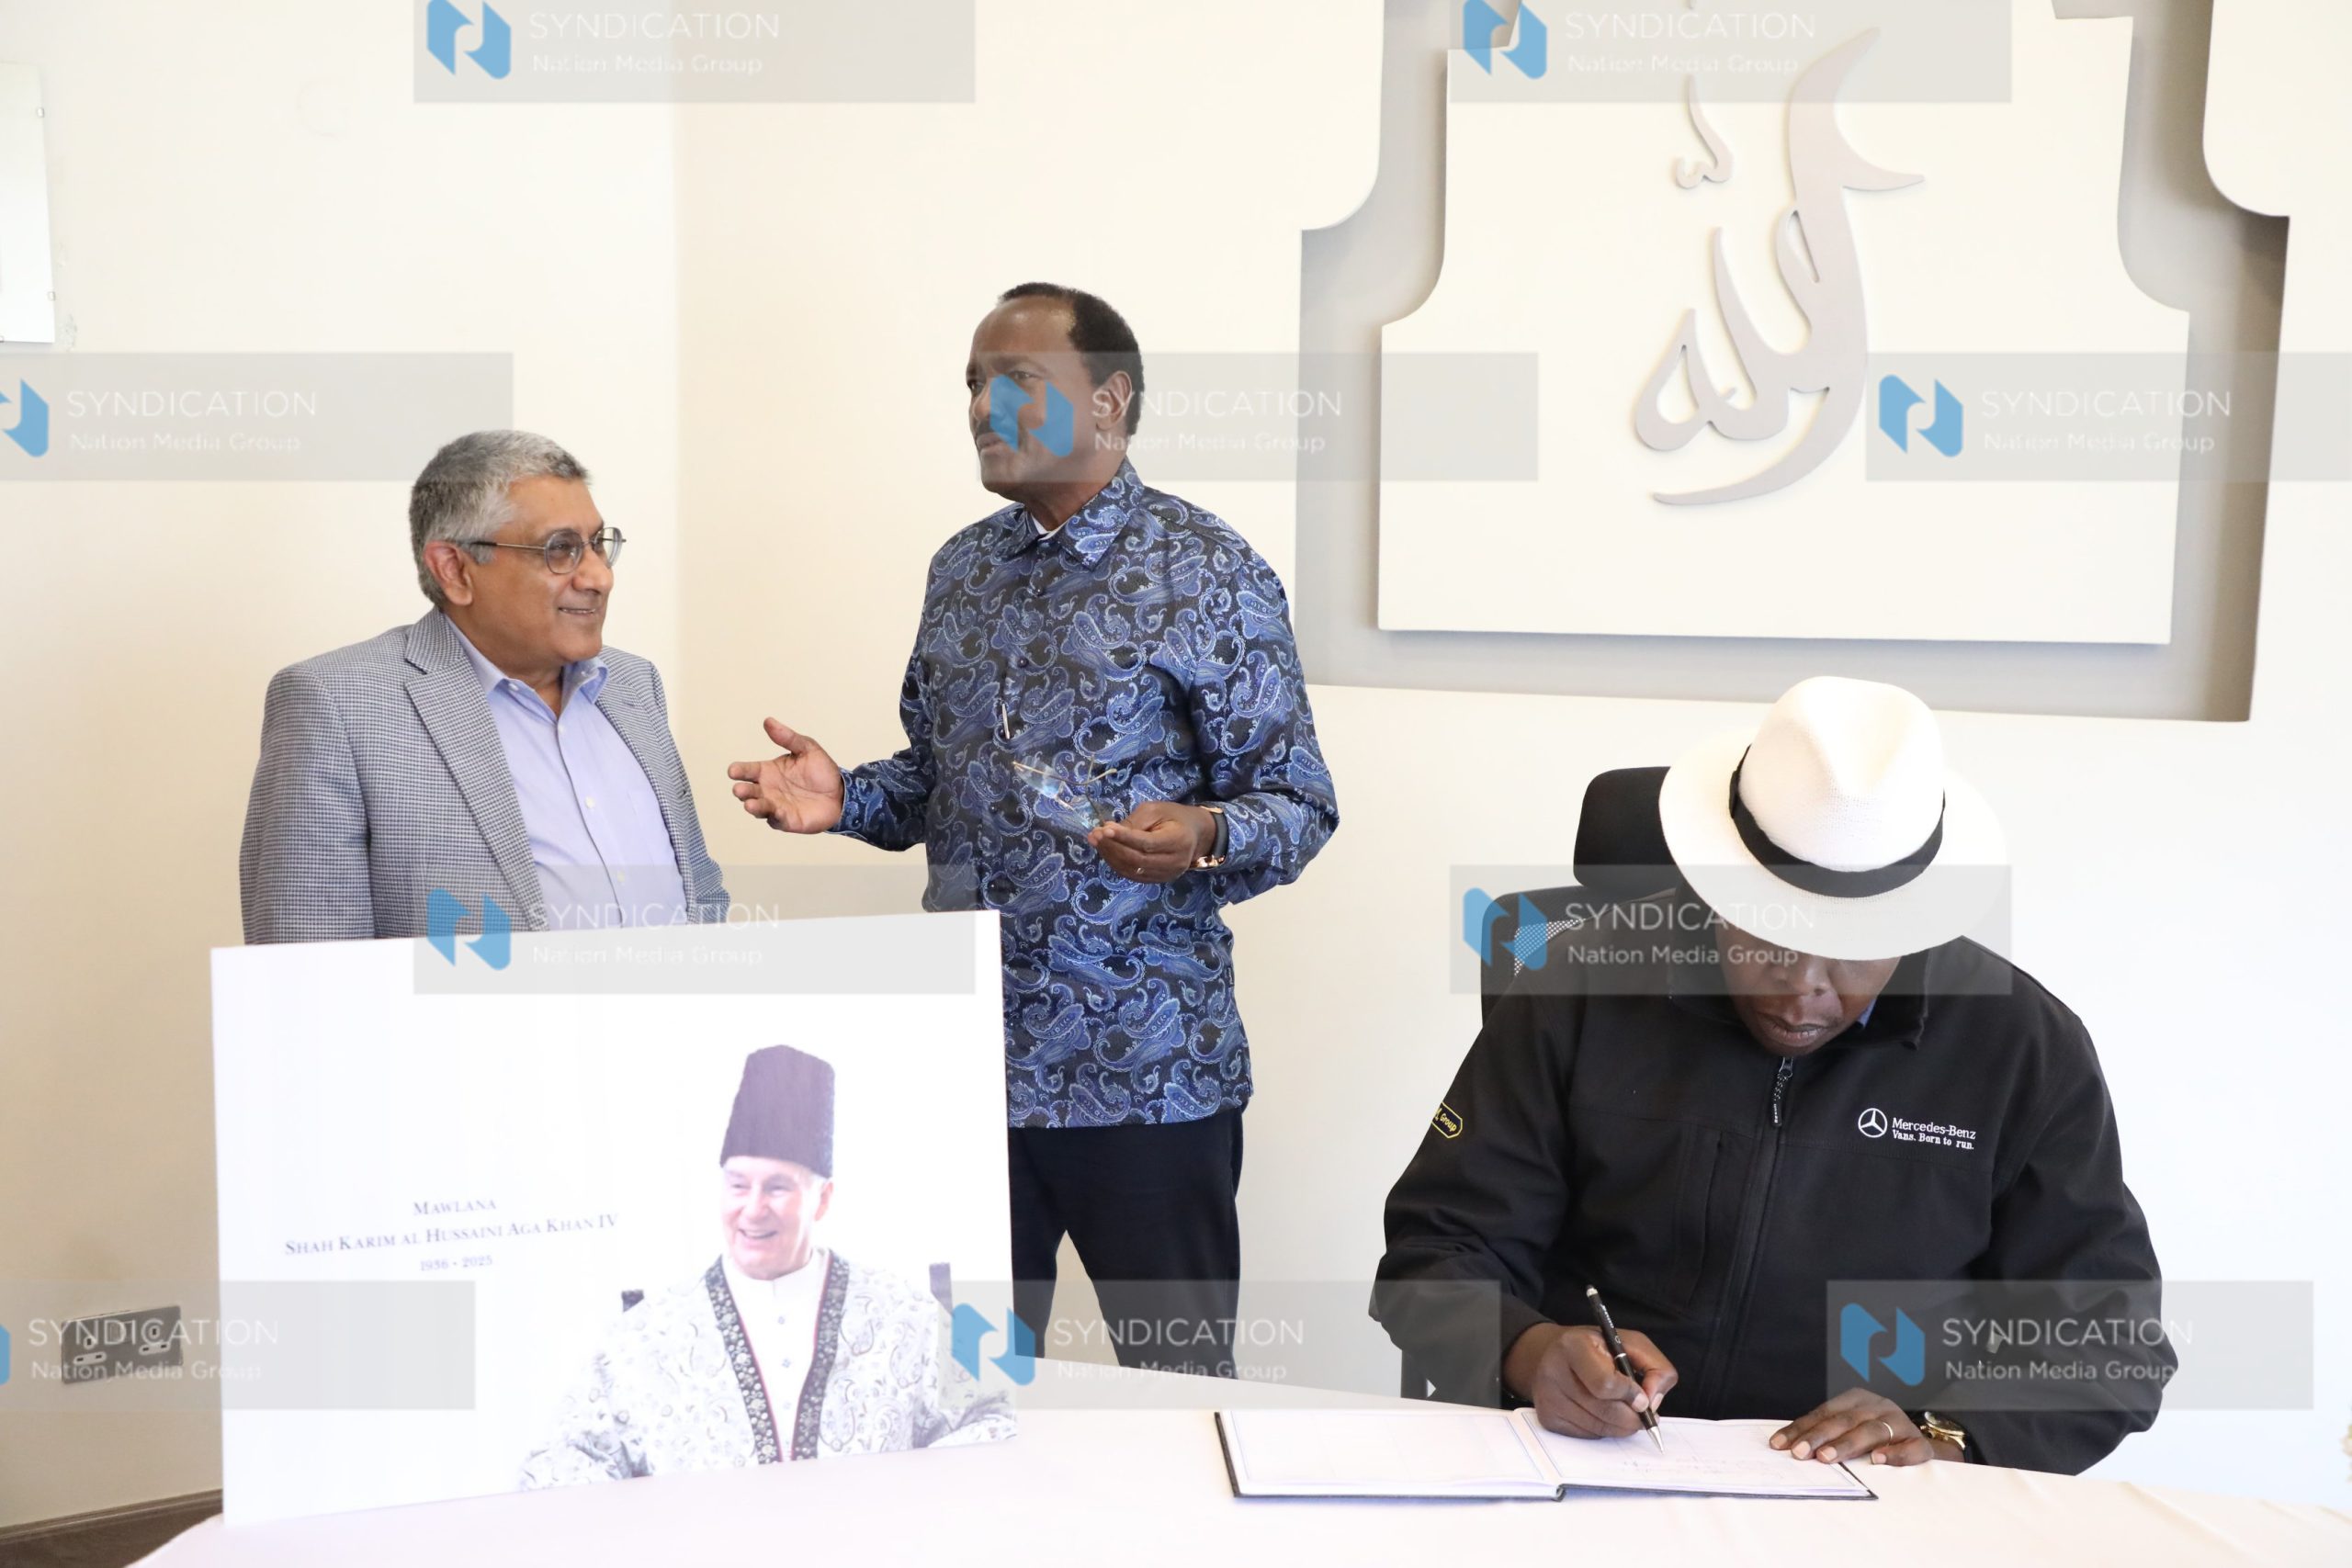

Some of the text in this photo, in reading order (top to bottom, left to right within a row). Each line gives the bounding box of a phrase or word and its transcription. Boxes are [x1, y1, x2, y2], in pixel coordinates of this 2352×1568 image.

[1892, 1117, 1976, 1139] Mercedes-Benz
[1892, 1129, 1974, 1149] Vans. Born to run.
[413, 1199, 497, 1216] MAWLANA
[285, 1239, 334, 1255] SHAH
[338, 1235, 396, 1251] KARIM
[425, 1224, 504, 1243] HUSSAINI
[507, 1221, 542, 1236] AGA
[546, 1216, 594, 1233] KHAN
[598, 1213, 618, 1228] IV
